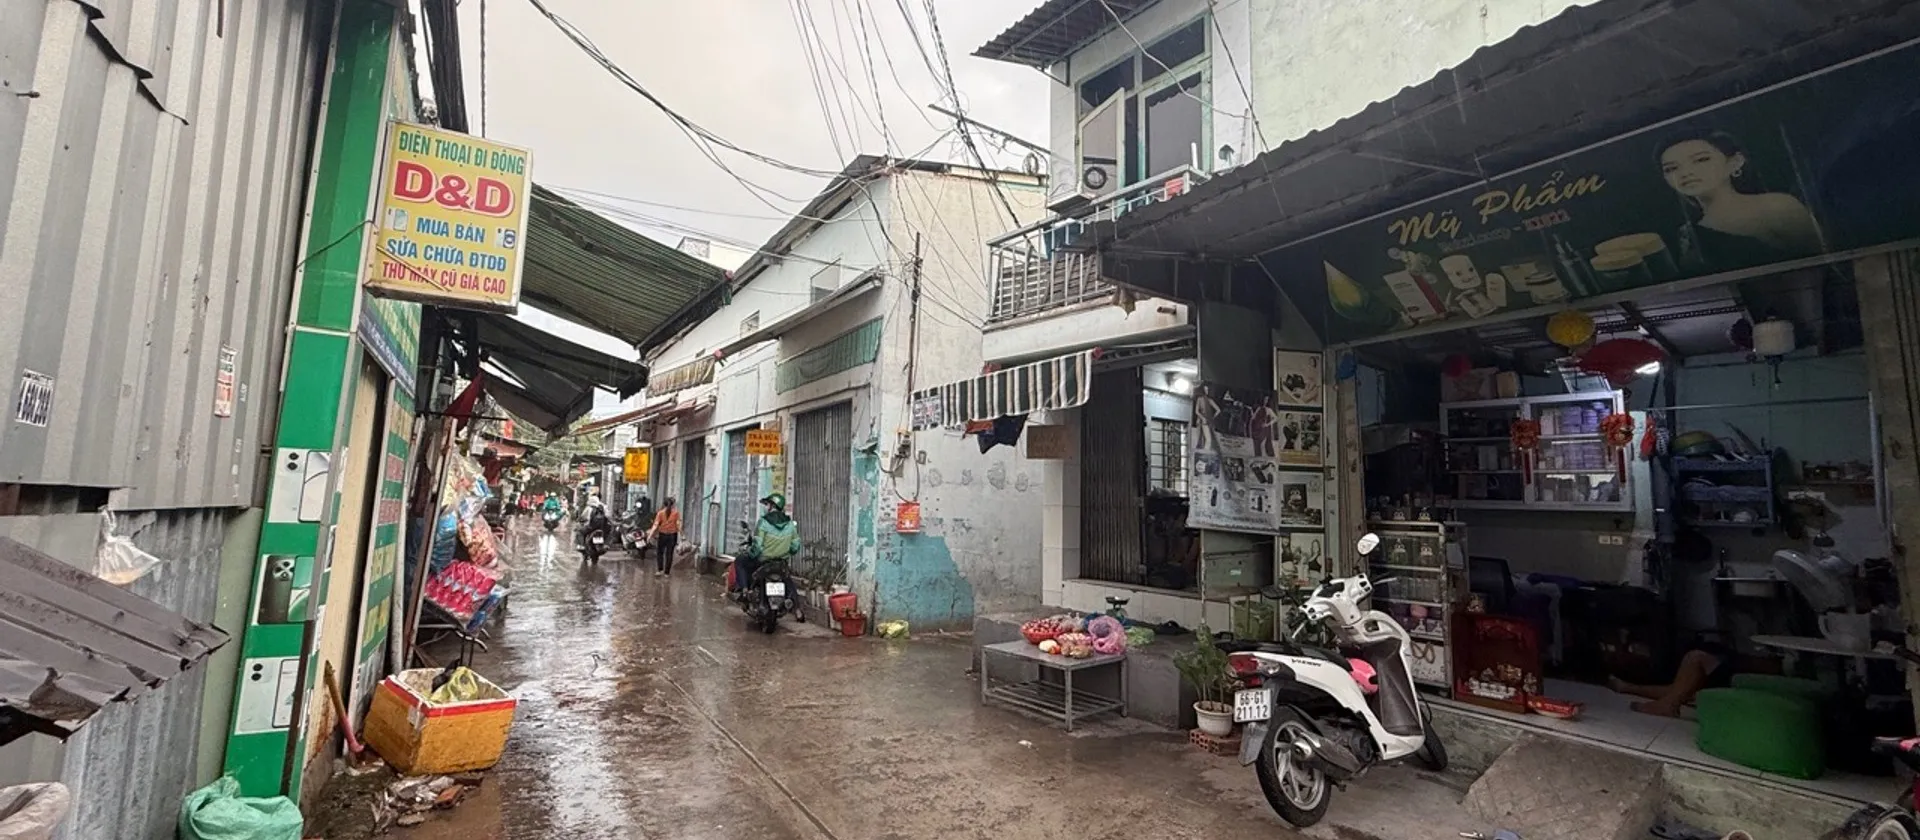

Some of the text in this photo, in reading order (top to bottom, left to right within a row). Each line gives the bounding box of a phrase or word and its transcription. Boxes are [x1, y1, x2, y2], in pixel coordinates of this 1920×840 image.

[399, 131, 524, 175] ĐIỆN THOẠI ĐI ĐỘNG
[393, 160, 513, 216] D&D
[1388, 209, 1462, 245] Mỹ
[1472, 171, 1607, 224] Phẩm
[416, 217, 486, 243] MUA BÁN
[387, 236, 418, 259] SỬA
[423, 244, 464, 266] CHỮA
[383, 261, 405, 280] THU
[440, 269, 457, 287] CŨ
[460, 272, 479, 290] GIÁ
[483, 277, 506, 294] CAO
[1236, 705, 1268, 721] 211.12
